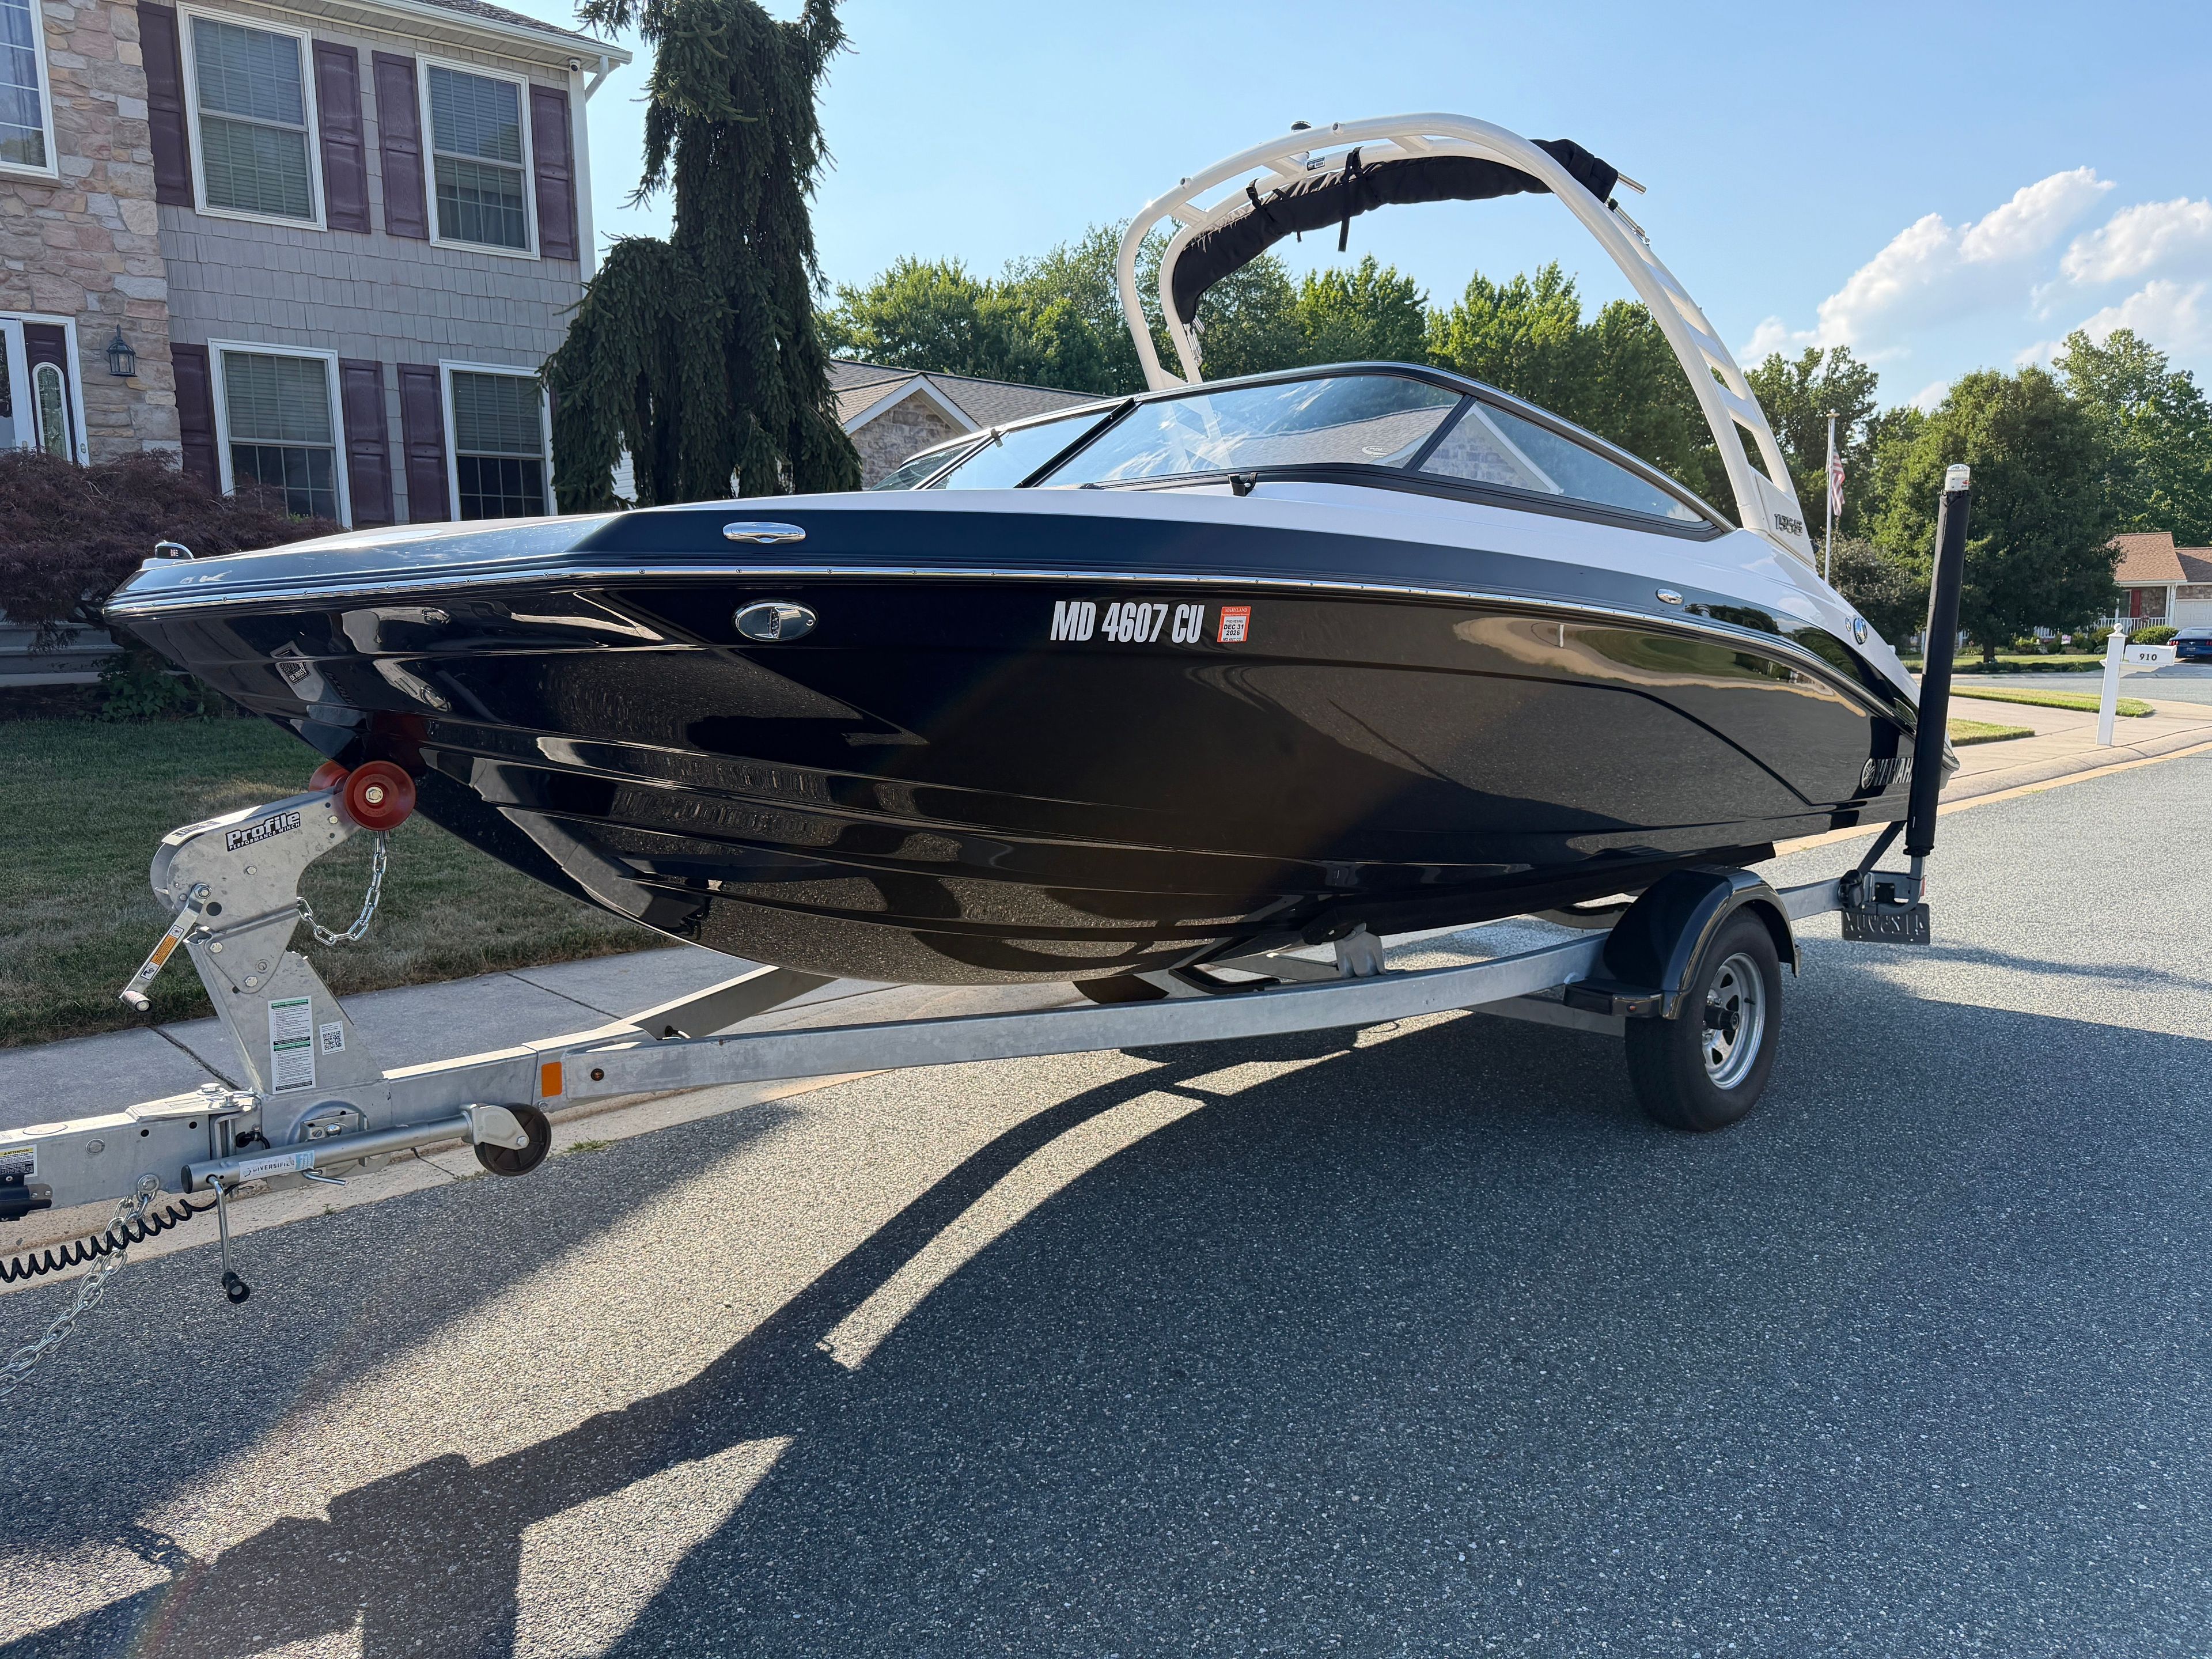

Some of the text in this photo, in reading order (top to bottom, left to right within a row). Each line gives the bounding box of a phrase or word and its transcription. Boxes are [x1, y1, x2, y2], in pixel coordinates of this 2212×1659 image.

[1050, 601, 1205, 643] MD 4607 CU
[1874, 757, 1914, 786] YAMAH
[227, 812, 300, 846] Profile
[229, 822, 300, 850] PERFORMANCE WINCH
